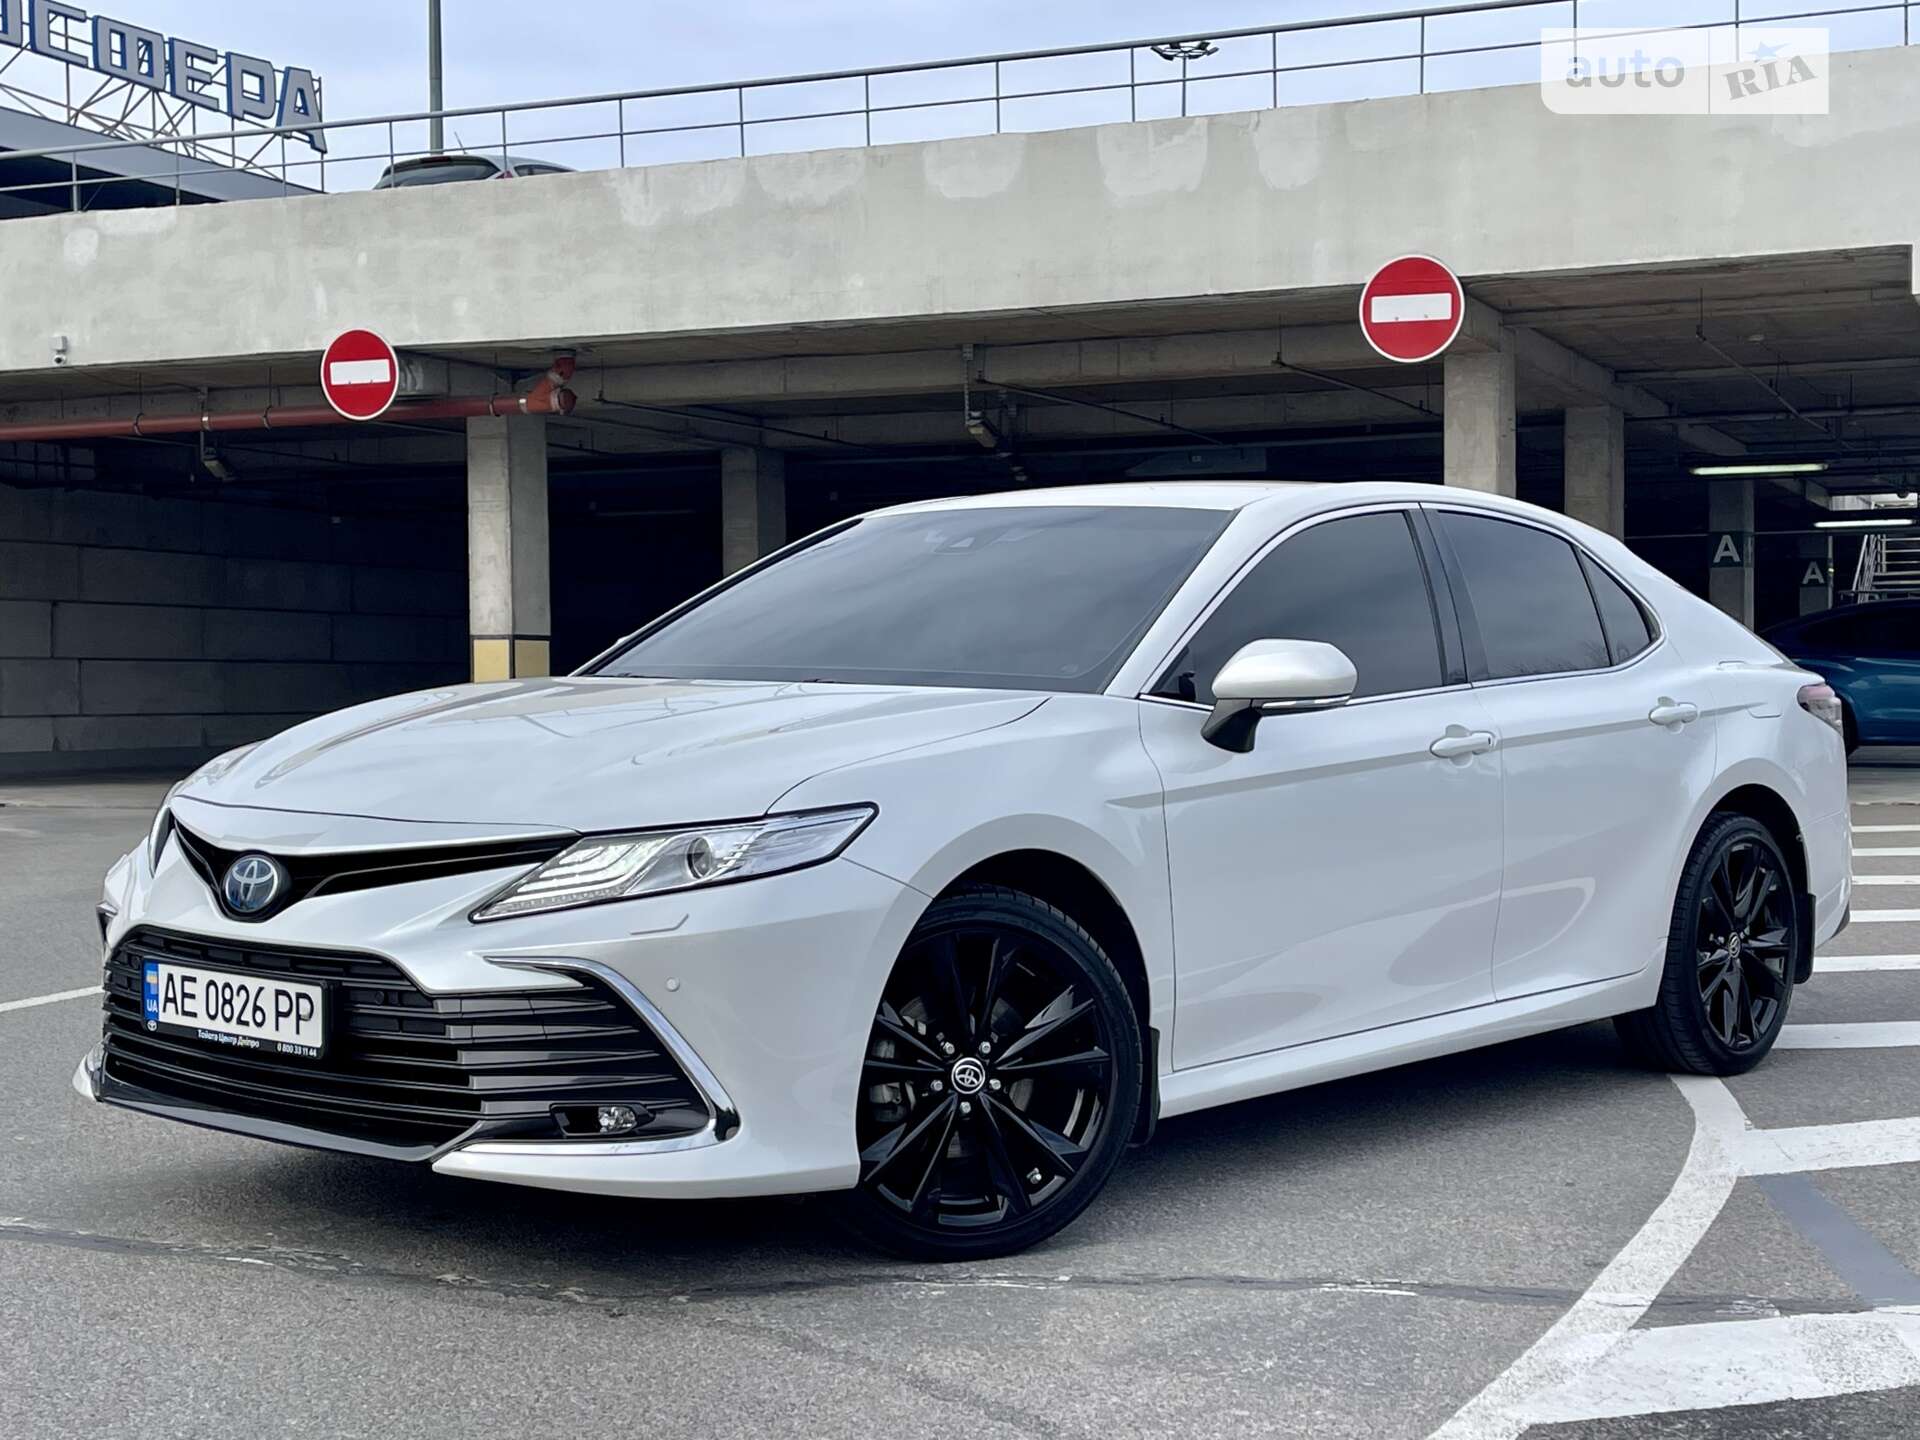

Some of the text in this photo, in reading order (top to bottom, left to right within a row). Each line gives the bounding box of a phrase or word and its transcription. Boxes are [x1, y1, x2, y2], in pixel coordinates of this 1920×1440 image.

[1713, 534, 1741, 563] A
[1802, 561, 1825, 585] A
[146, 999, 159, 1013] UA
[162, 973, 315, 1035] AE 0826 PP
